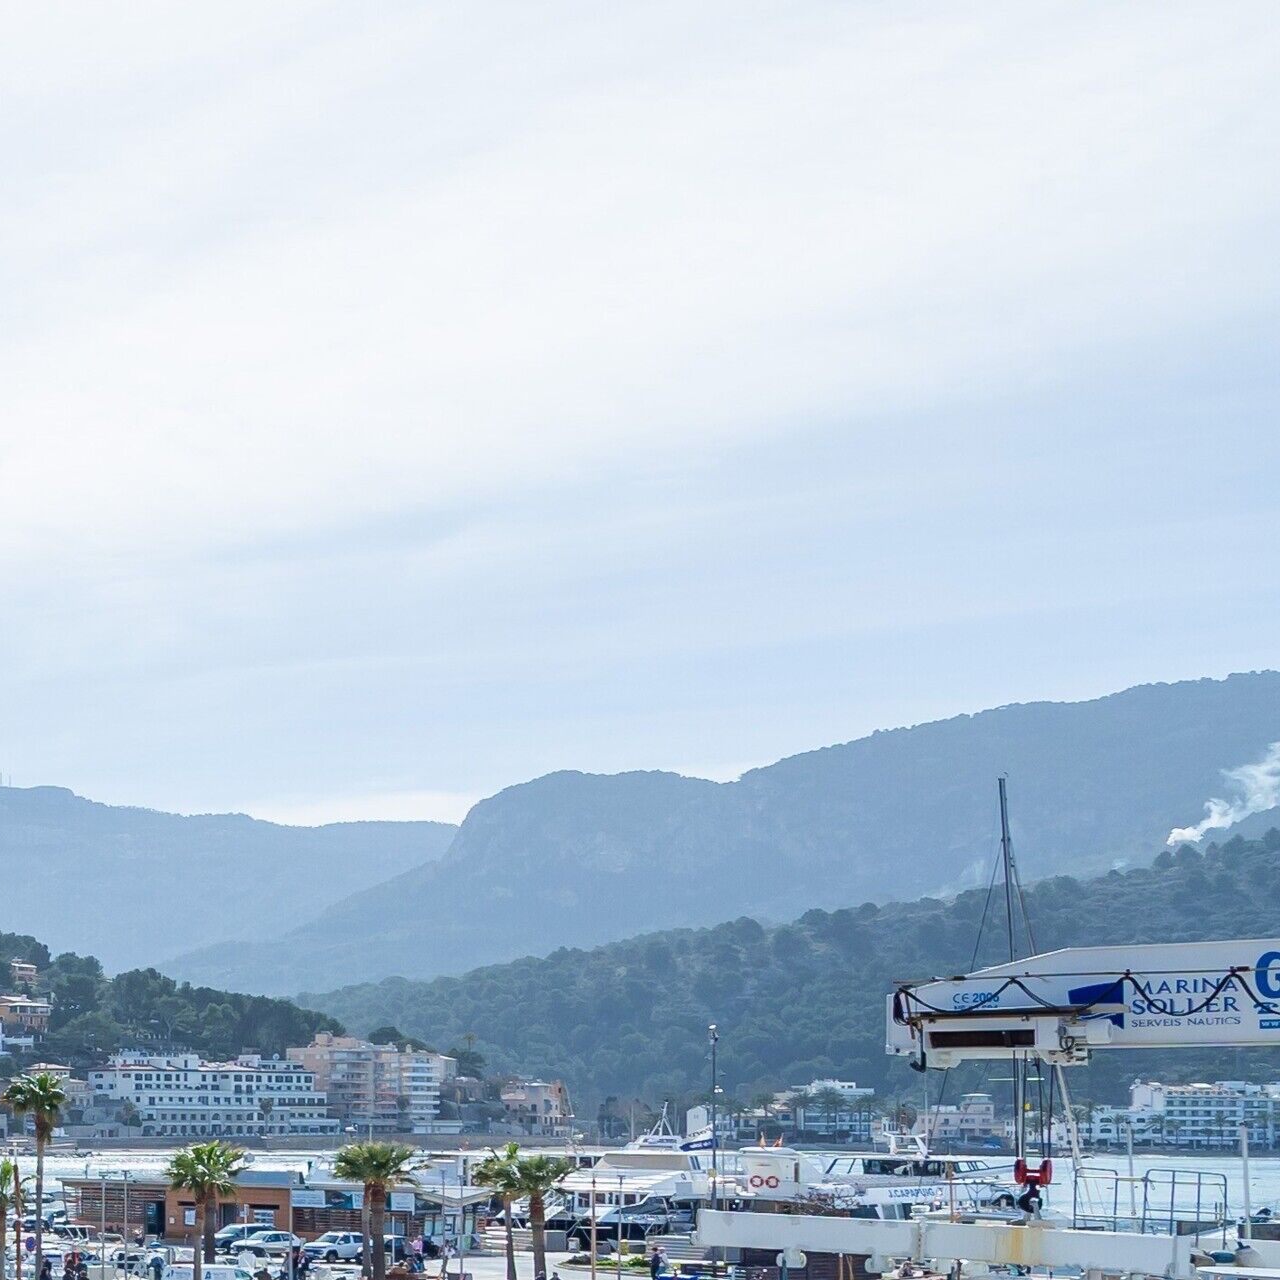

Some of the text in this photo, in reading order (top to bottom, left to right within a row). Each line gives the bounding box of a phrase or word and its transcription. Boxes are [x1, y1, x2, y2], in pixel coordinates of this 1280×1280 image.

[1132, 977, 1239, 996] MARINA
[1131, 996, 1240, 1015] SOLLER
[1131, 1016, 1242, 1029] SERVEIS NAUTICS
